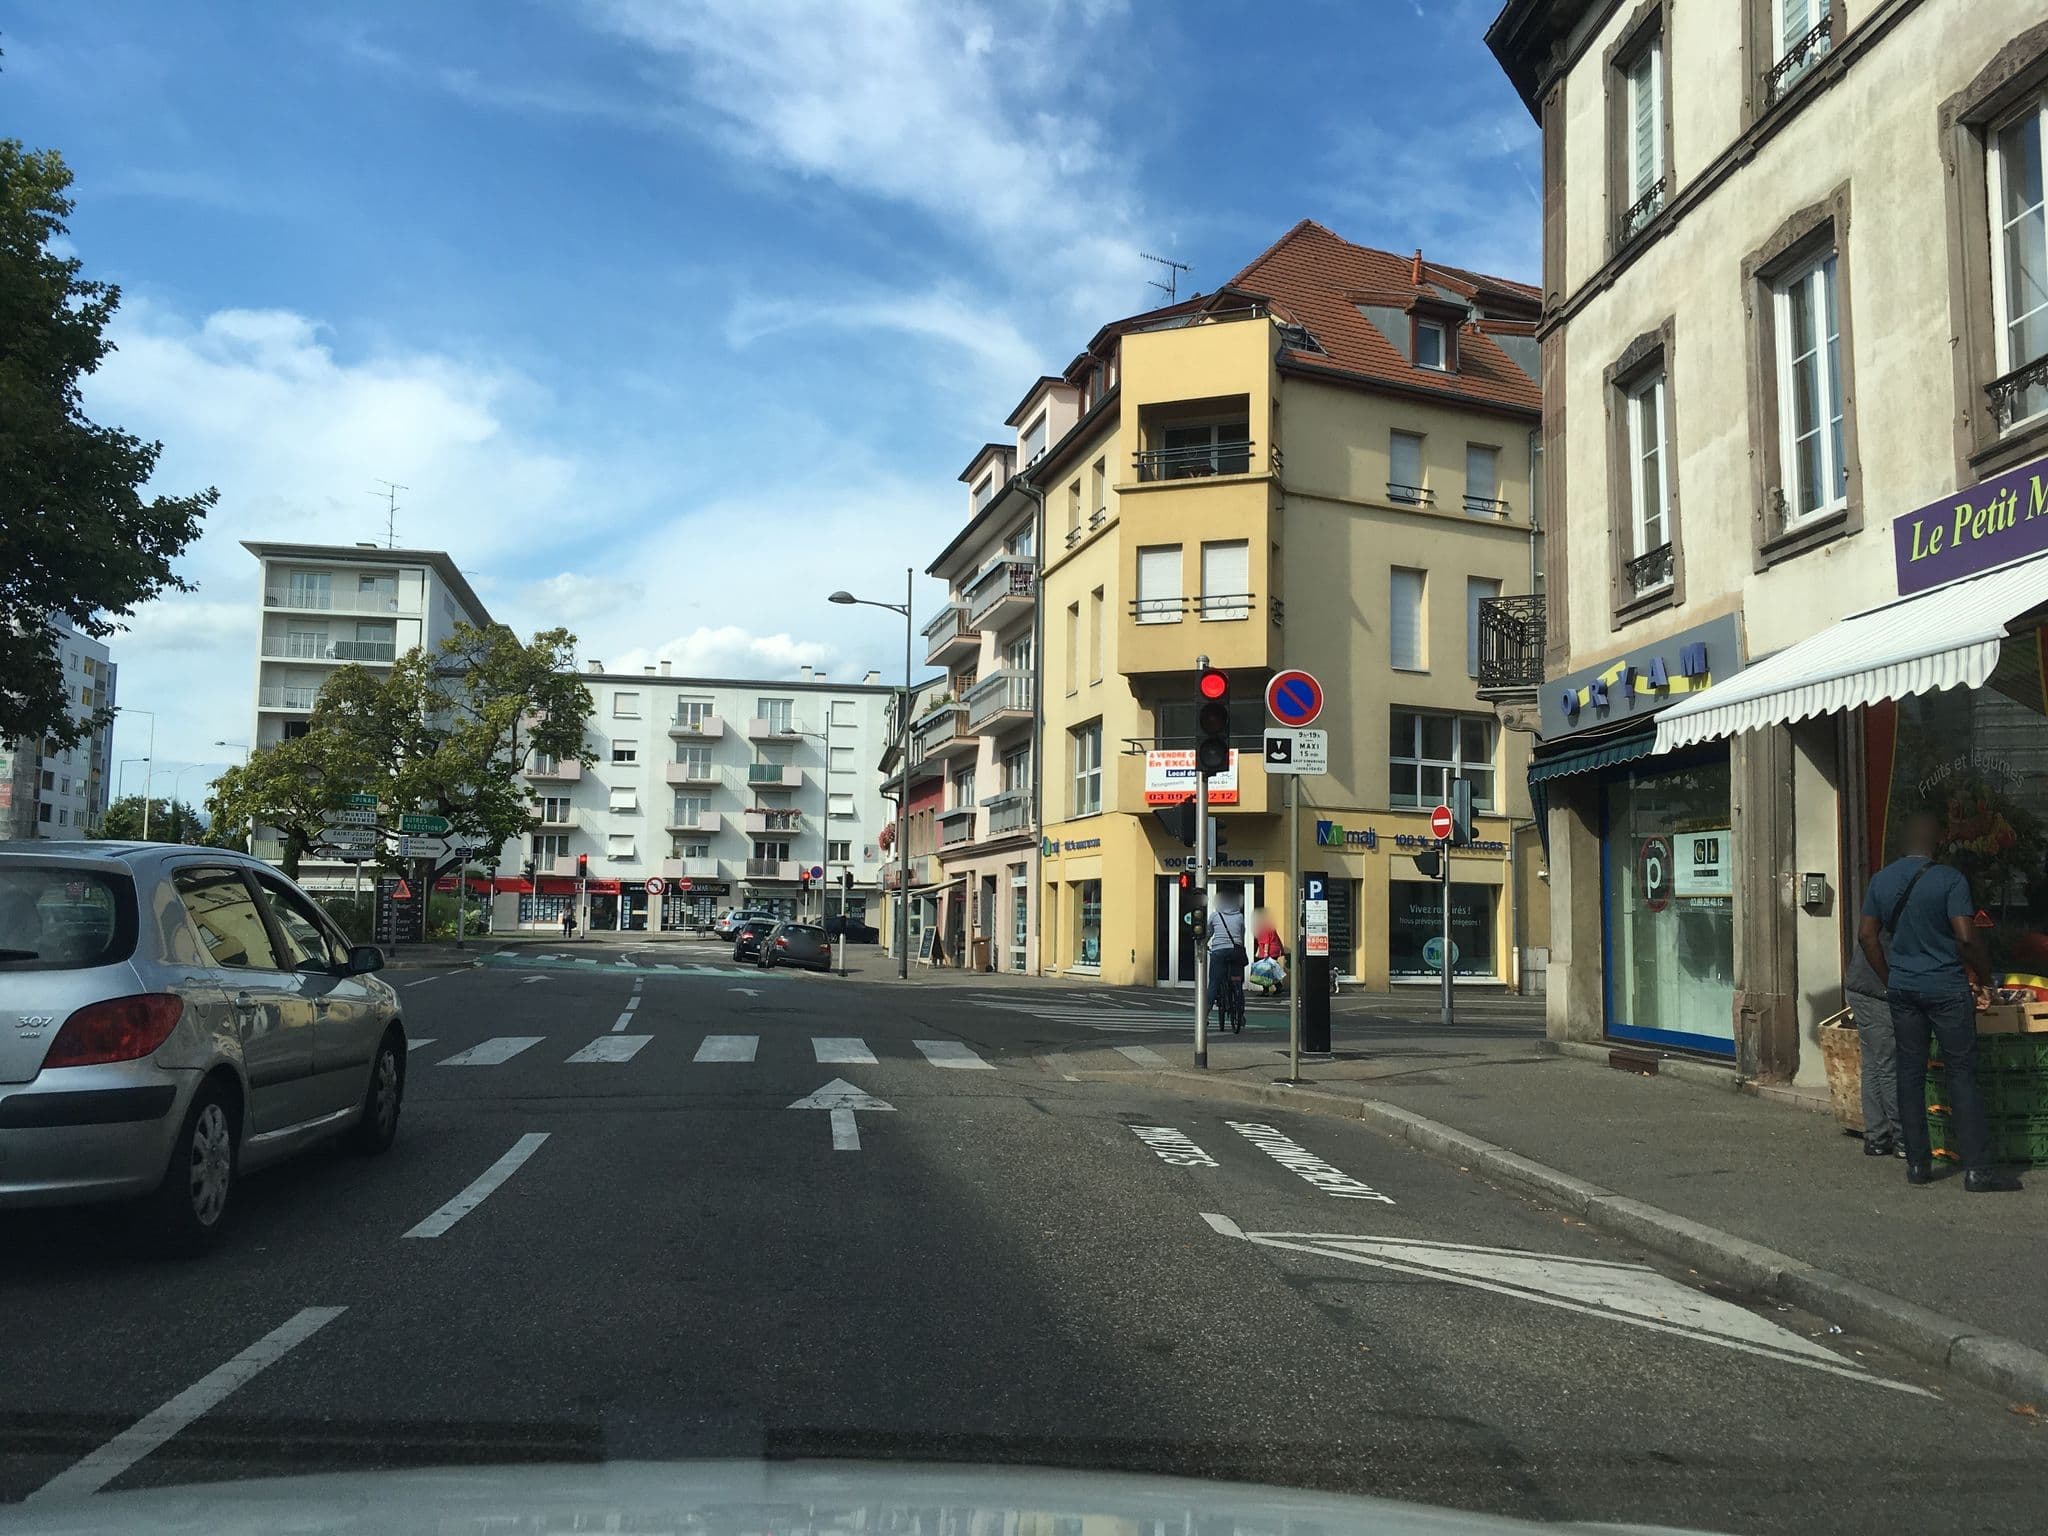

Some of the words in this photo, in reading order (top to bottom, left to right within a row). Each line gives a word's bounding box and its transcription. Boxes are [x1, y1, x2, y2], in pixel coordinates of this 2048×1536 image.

[1909, 520, 1944, 562] Le
[1950, 488, 2018, 548] Petit
[1918, 762, 1951, 799] Fruits
[1954, 753, 1967, 770] et
[1395, 833, 1414, 845] 100
[1309, 880, 1322, 899] P
[1410, 904, 1431, 913] Vivez
[15, 1016, 54, 1028] 307
[1129, 1125, 1220, 1167] MINUTES
[1225, 1121, 1396, 1205] STATIONNEMENT
